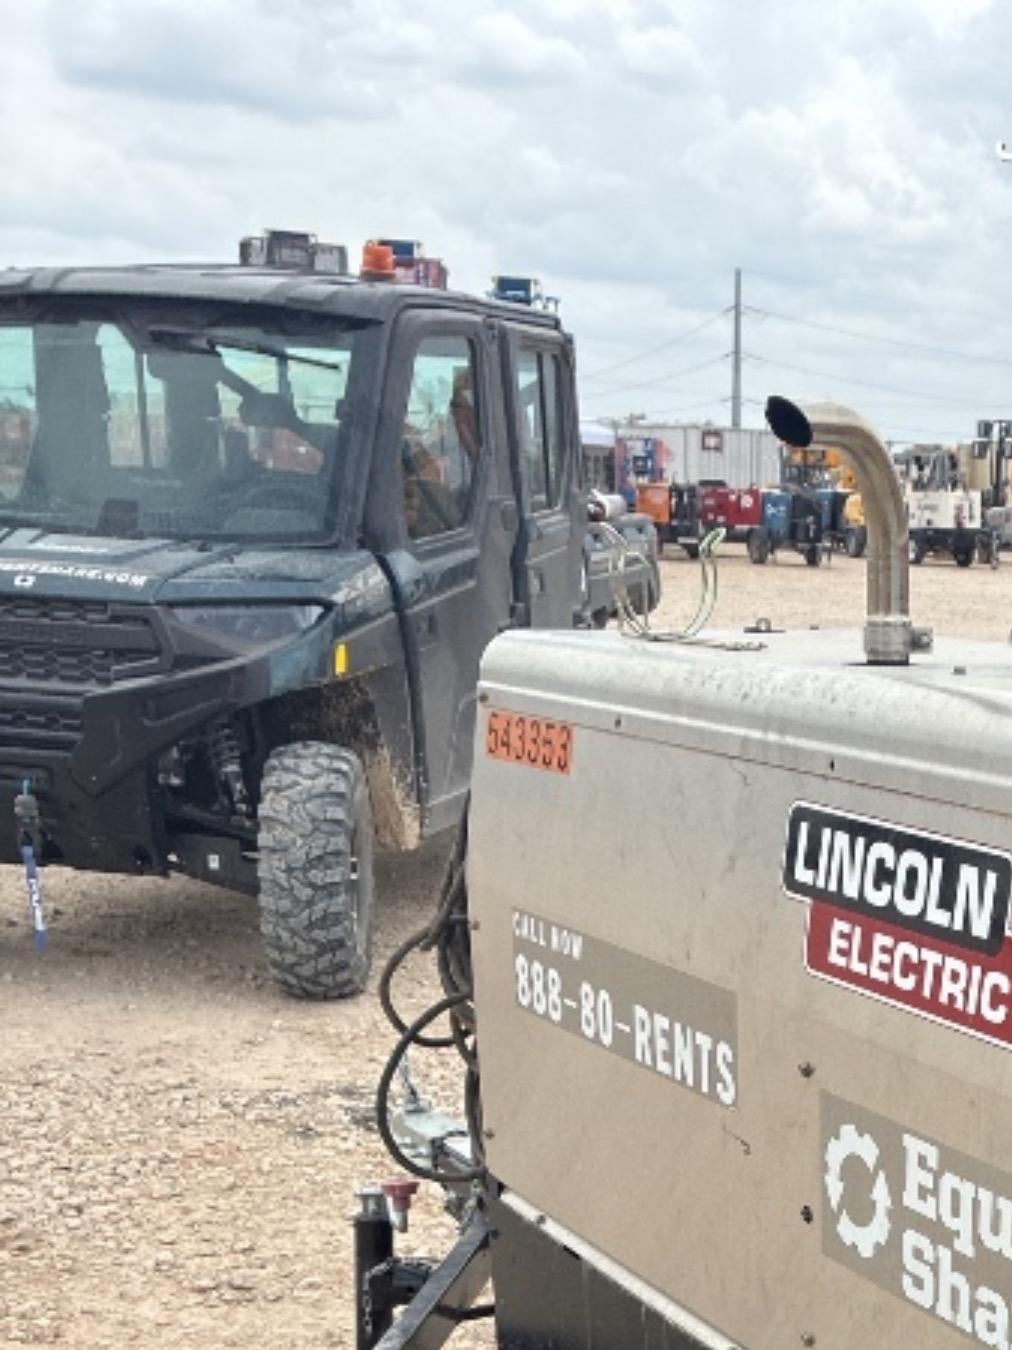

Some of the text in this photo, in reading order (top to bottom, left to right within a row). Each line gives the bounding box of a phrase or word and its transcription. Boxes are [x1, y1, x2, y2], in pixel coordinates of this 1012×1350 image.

[488, 711, 571, 772] 543353
[793, 820, 998, 941] LINCOLN
[512, 910, 583, 961] CALL NOW
[827, 917, 1012, 1025] ELECTRIC
[515, 952, 737, 1106] 888-80-RENTS
